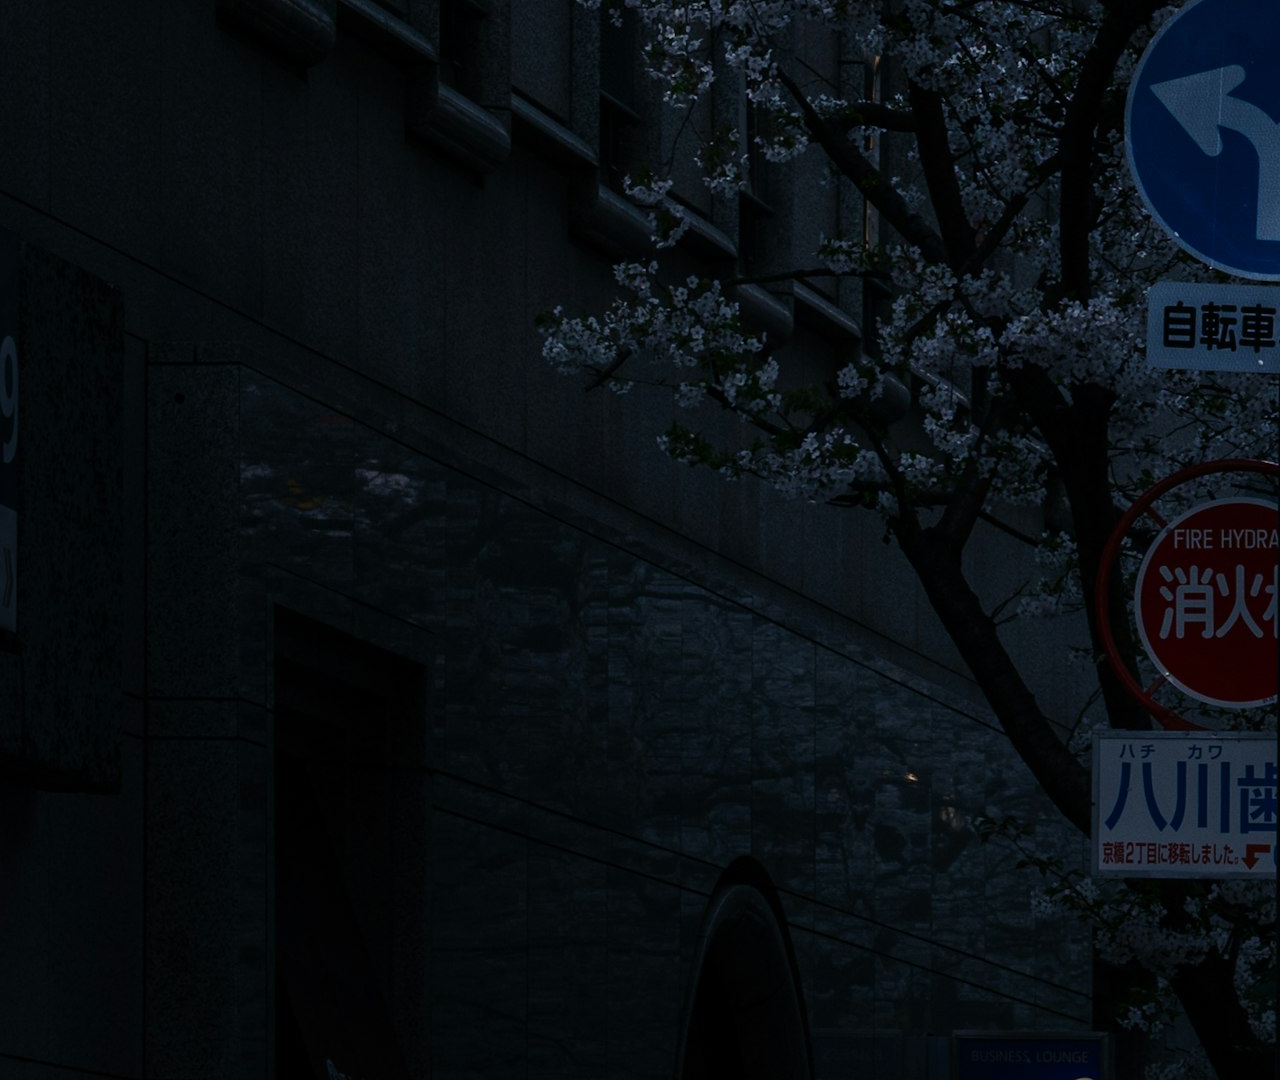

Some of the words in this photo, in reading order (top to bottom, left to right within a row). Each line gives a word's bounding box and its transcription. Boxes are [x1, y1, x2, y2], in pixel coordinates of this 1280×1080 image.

[1174, 529, 1214, 550] FIRE
[1120, 744, 1155, 759] ハチ
[1188, 744, 1223, 760] カワ
[970, 1049, 1030, 1064] BUSINESS
[1035, 1049, 1090, 1065] LOUNGE
